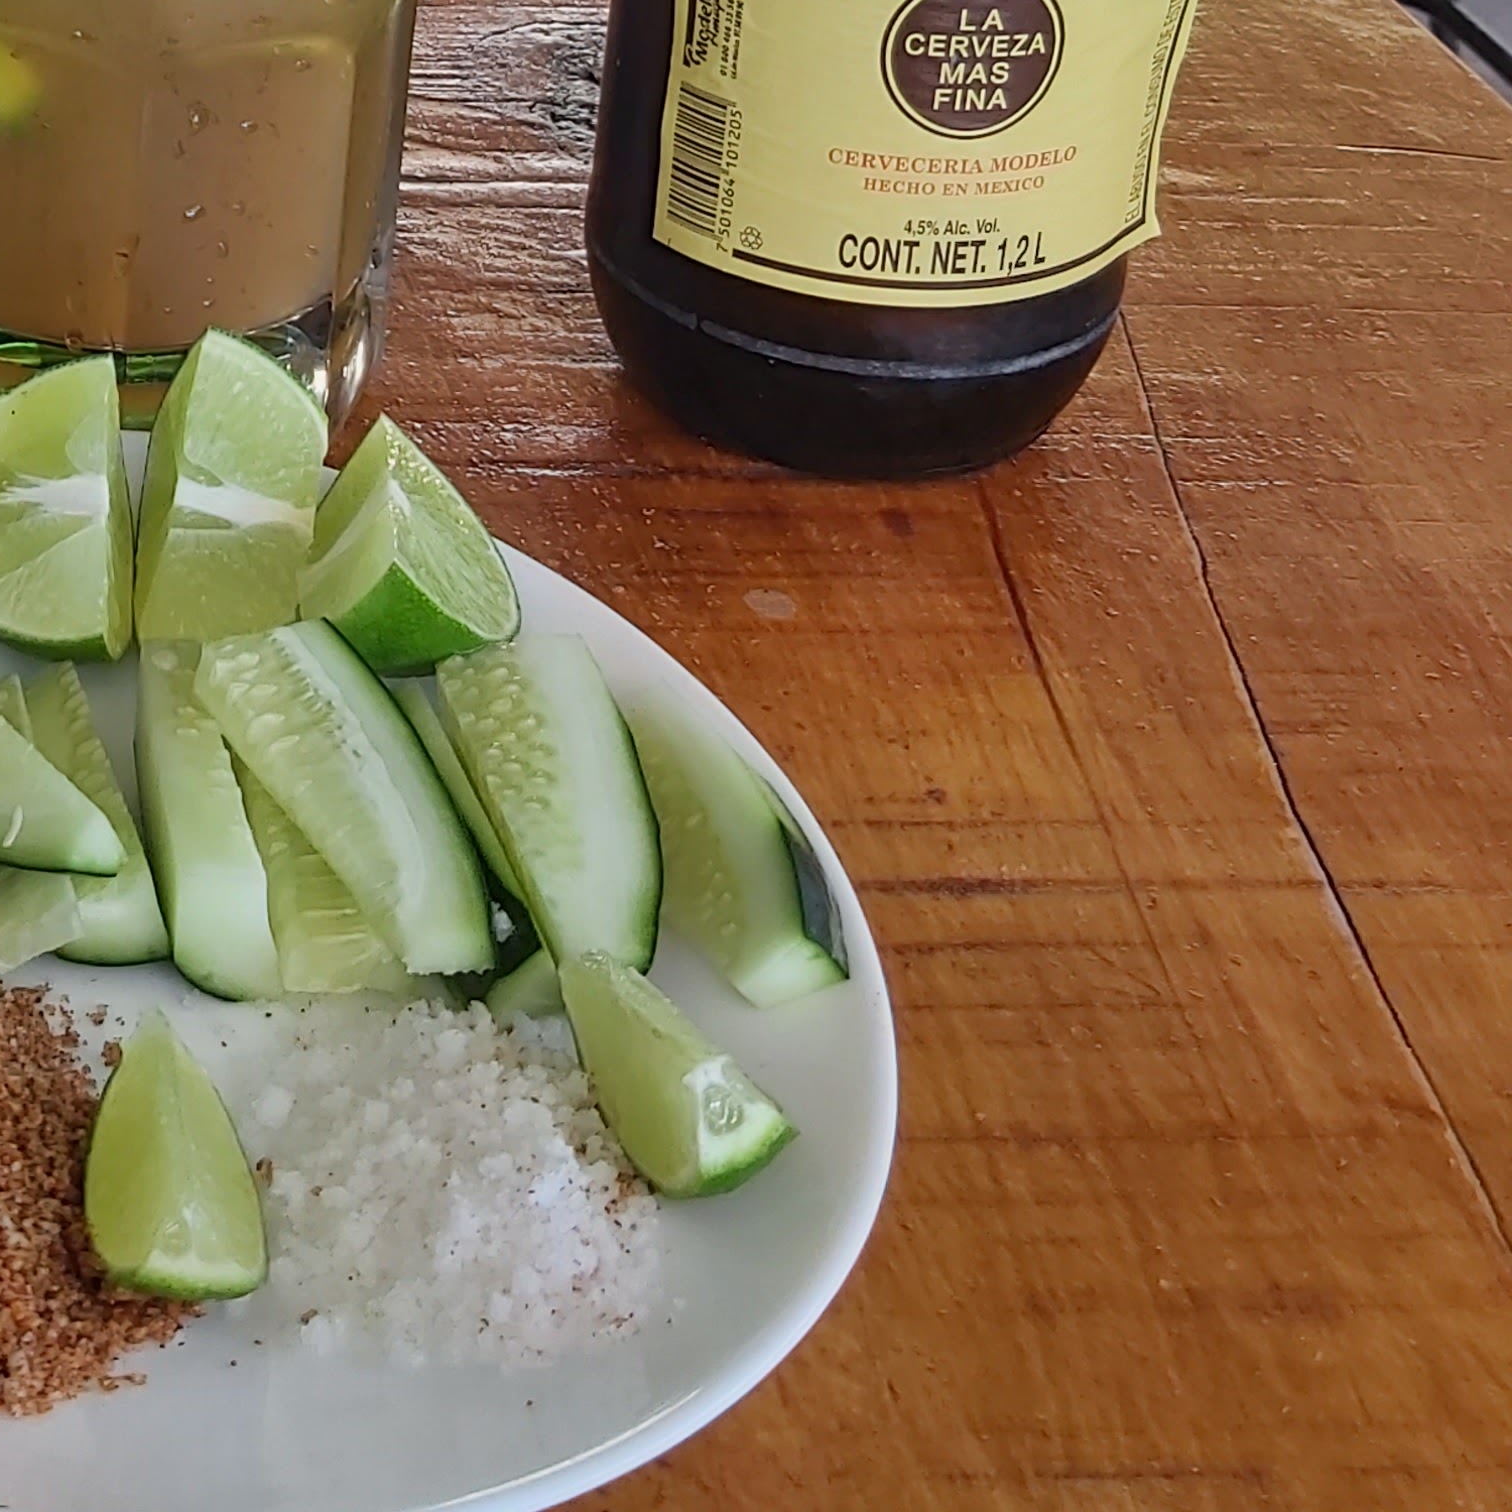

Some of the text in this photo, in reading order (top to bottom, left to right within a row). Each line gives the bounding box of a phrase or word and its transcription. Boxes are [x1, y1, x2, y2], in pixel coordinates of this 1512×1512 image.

[959, 8, 1004, 32] LA
[904, 32, 1046, 58] CERVEZA
[939, 62, 1010, 85] MAS
[932, 88, 1008, 111] FINA
[828, 145, 1077, 175] CERVECERIA MODELO
[863, 175, 1045, 196] HECHO EN MEXICO
[904, 217, 1001, 237] 4,5% Alc. Vol.
[838, 233, 921, 275] CONT.
[930, 238, 986, 275] NET.
